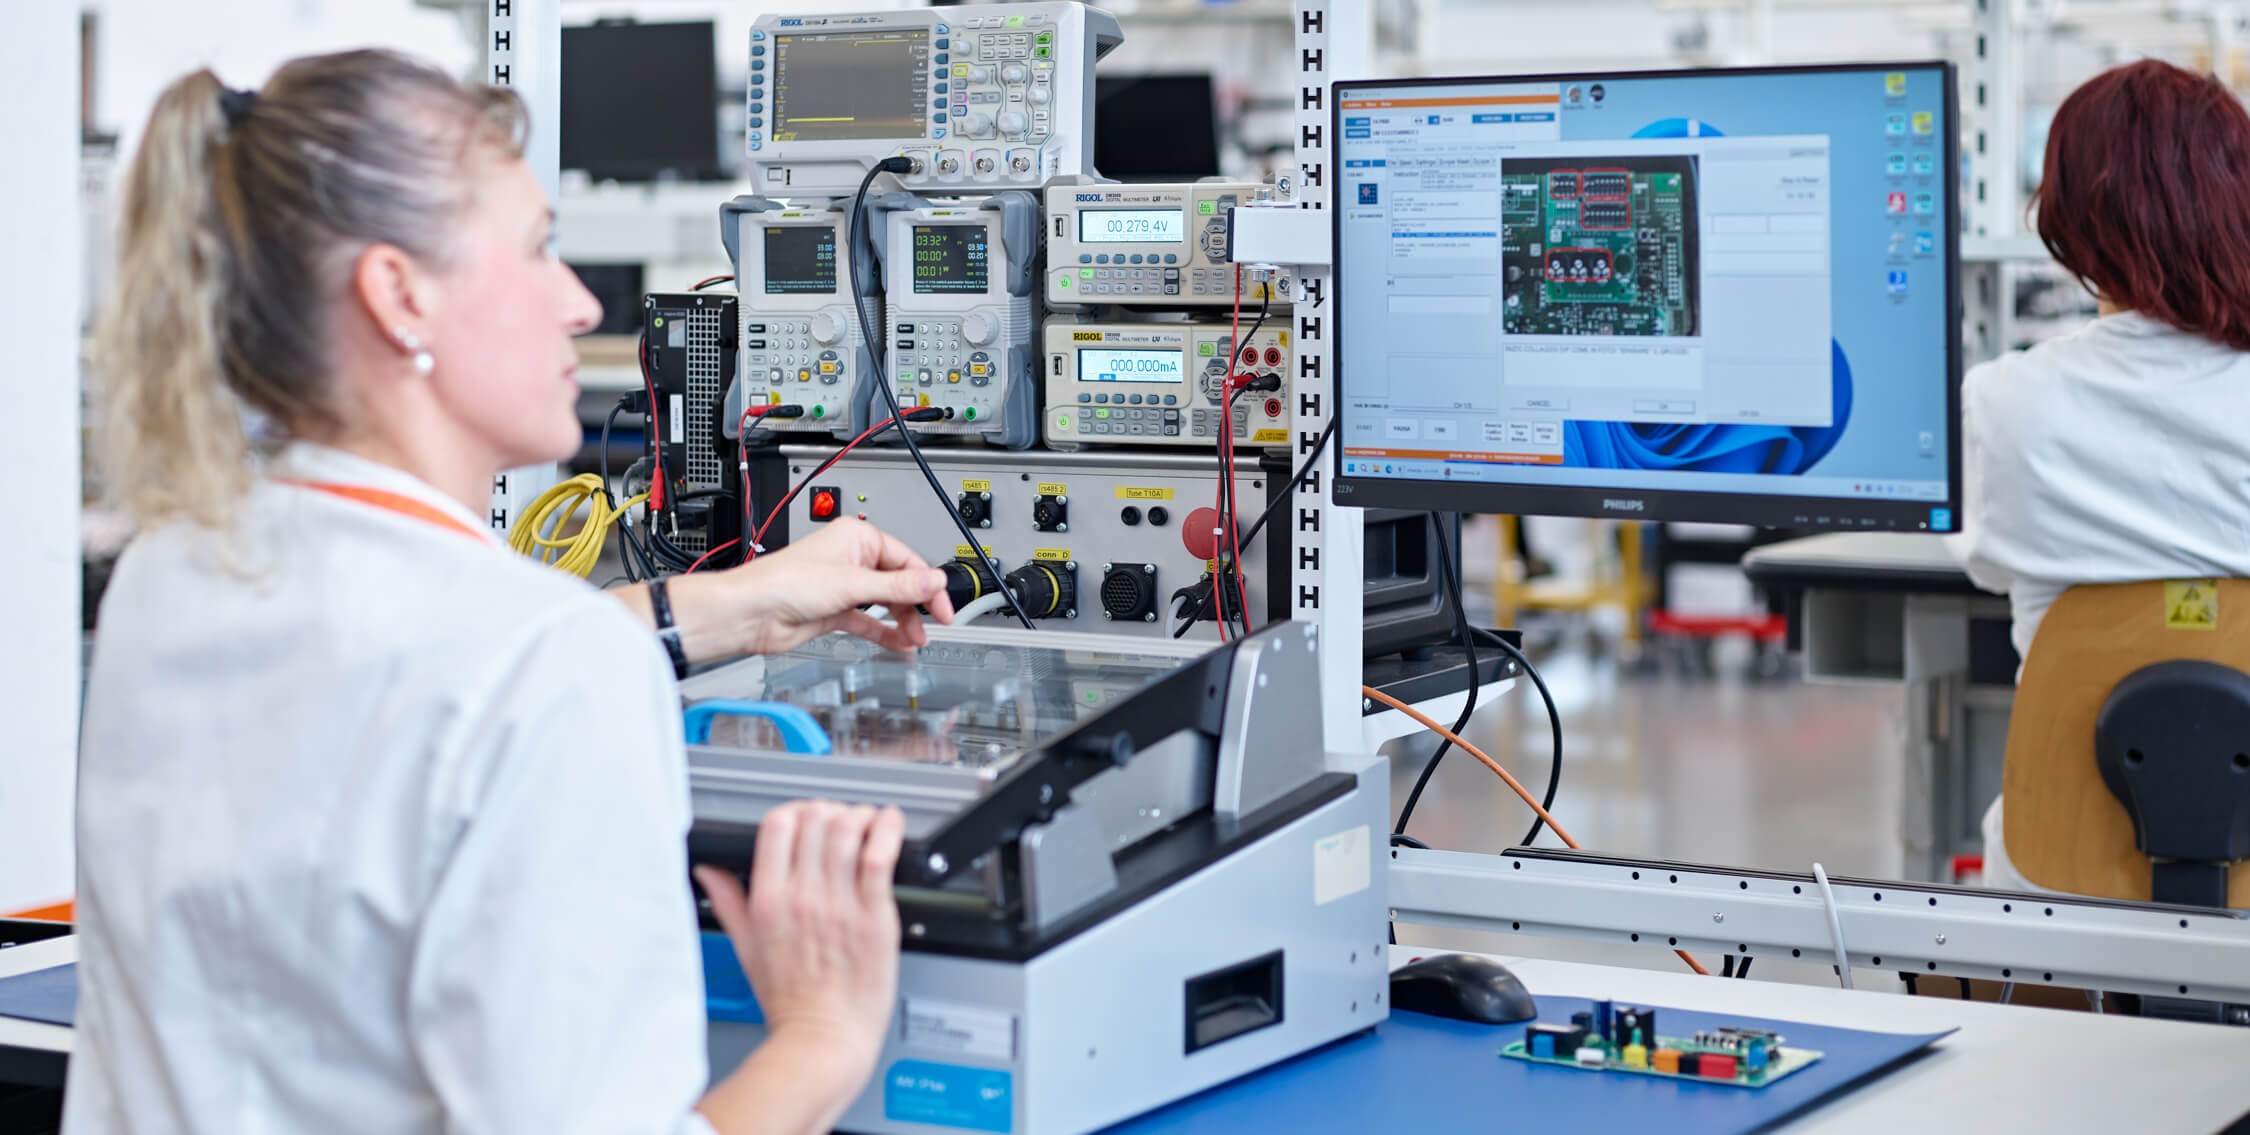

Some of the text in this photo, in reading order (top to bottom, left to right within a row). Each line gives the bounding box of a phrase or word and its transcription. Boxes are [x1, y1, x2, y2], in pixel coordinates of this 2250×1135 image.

[1076, 193, 1104, 202] RIGOL
[916, 234, 942, 247] 03.32
[916, 250, 943, 262] 00.00
[1073, 332, 1103, 341] RIGOL
[1041, 485, 1057, 493] rs485
[1128, 489, 1142, 497] fuse
[1602, 498, 1645, 511] PHILIPS
[1036, 551, 1057, 559] conn
